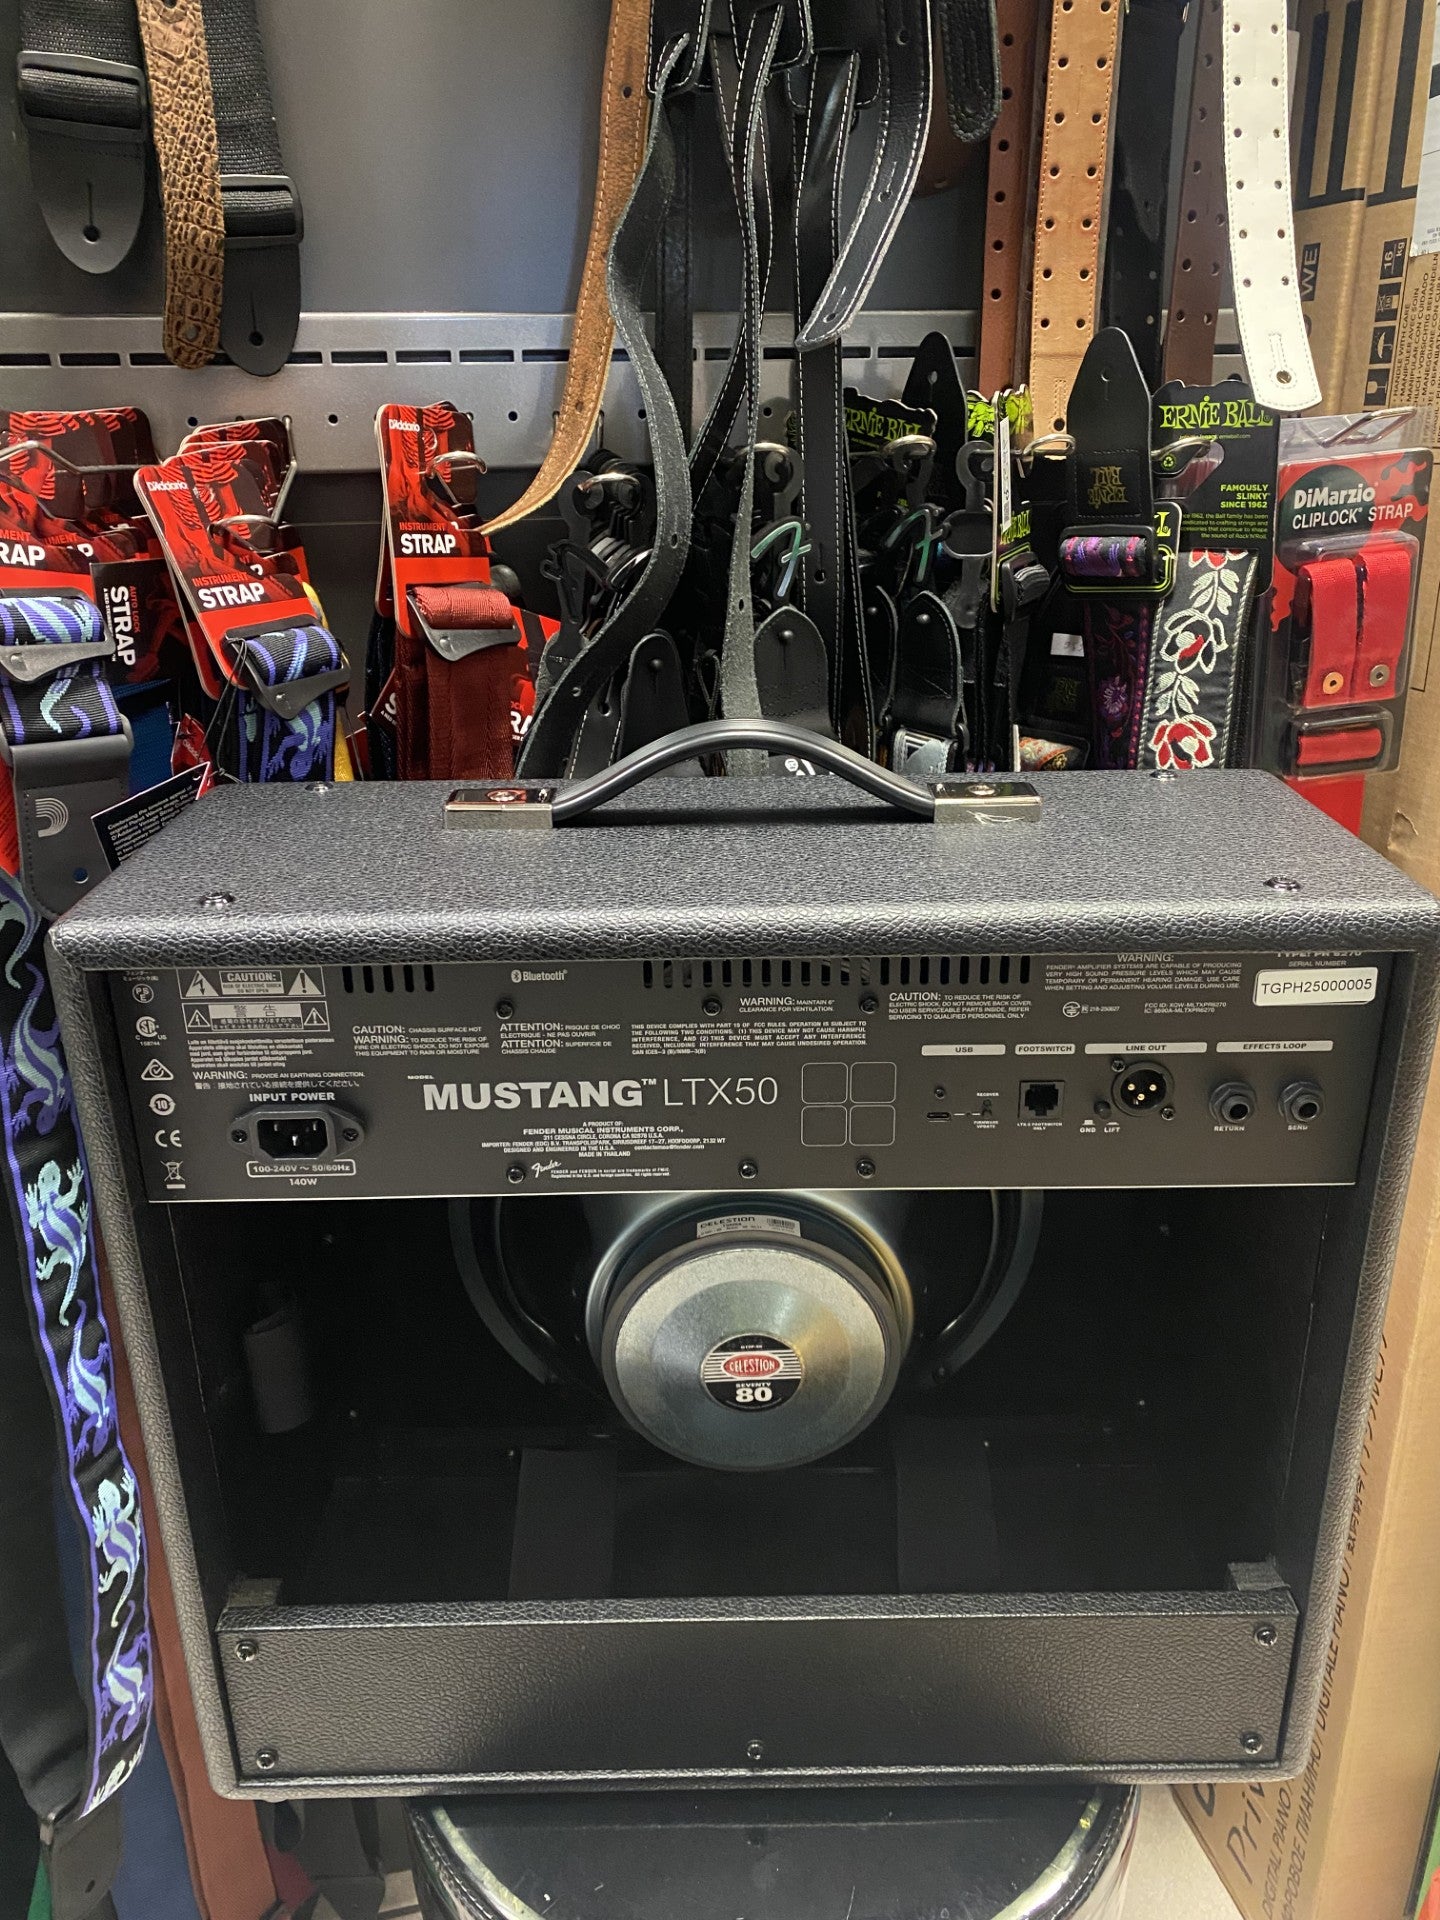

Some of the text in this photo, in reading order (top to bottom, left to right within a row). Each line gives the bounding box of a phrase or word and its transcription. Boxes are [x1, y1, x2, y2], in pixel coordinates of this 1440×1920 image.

[1396, 242, 1405, 256] kg
[1384, 251, 1393, 270] 16
[1418, 313, 1430, 368] VORSICHTIG
[1425, 254, 1438, 312] BEHANDELN
[1400, 288, 1419, 396] MANIPULER AVEC SOIN
[1406, 272, 1428, 402] MANIPULAR CON CUIDADO
[1392, 304, 1410, 396] HANDLE WITH CARE
[1422, 328, 1435, 396] MANEGGIARE
[1430, 304, 1439, 326] CON
[388, 418, 420, 432] D'Addario
[146, 481, 189, 492] D'Addario
[1294, 484, 1376, 510] DiMarzio
[1368, 502, 1414, 522] STRAP
[399, 522, 446, 531] INSTRUMENT
[401, 534, 456, 554] STRAP
[192, 572, 249, 587] INSTRUMENT
[198, 582, 265, 609] STRAP
[130, 586, 140, 633] AUTO LOCK
[110, 586, 136, 666] STRAP
[1118, 954, 1174, 962] WARNING:
[226, 972, 276, 982] CAUTION:
[1261, 979, 1372, 996] TGPH25000005
[740, 997, 795, 1006] WARNING:
[889, 992, 941, 1001] CAUTION:
[352, 1025, 405, 1034] CAUTION:
[500, 1022, 564, 1032] ATTENTION:
[354, 1035, 409, 1044] WARNING:
[501, 1039, 564, 1048] ATTENTION:
[193, 1071, 248, 1080] WARNING:
[249, 1092, 335, 1101] INPUT POWER
[664, 1077, 778, 1106] LTX50
[157, 1100, 168, 1109] 10
[155, 1130, 182, 1148] CE
[253, 1164, 350, 1172] 100-240V 50/60Hz
[531, 1160, 562, 1178] Fender
[701, 1217, 755, 1228] CELESTION
[729, 1358, 775, 1372] CELESTION
[735, 1387, 772, 1403] 80
[1262, 1787, 1291, 1920] DIGITAL PIANO
